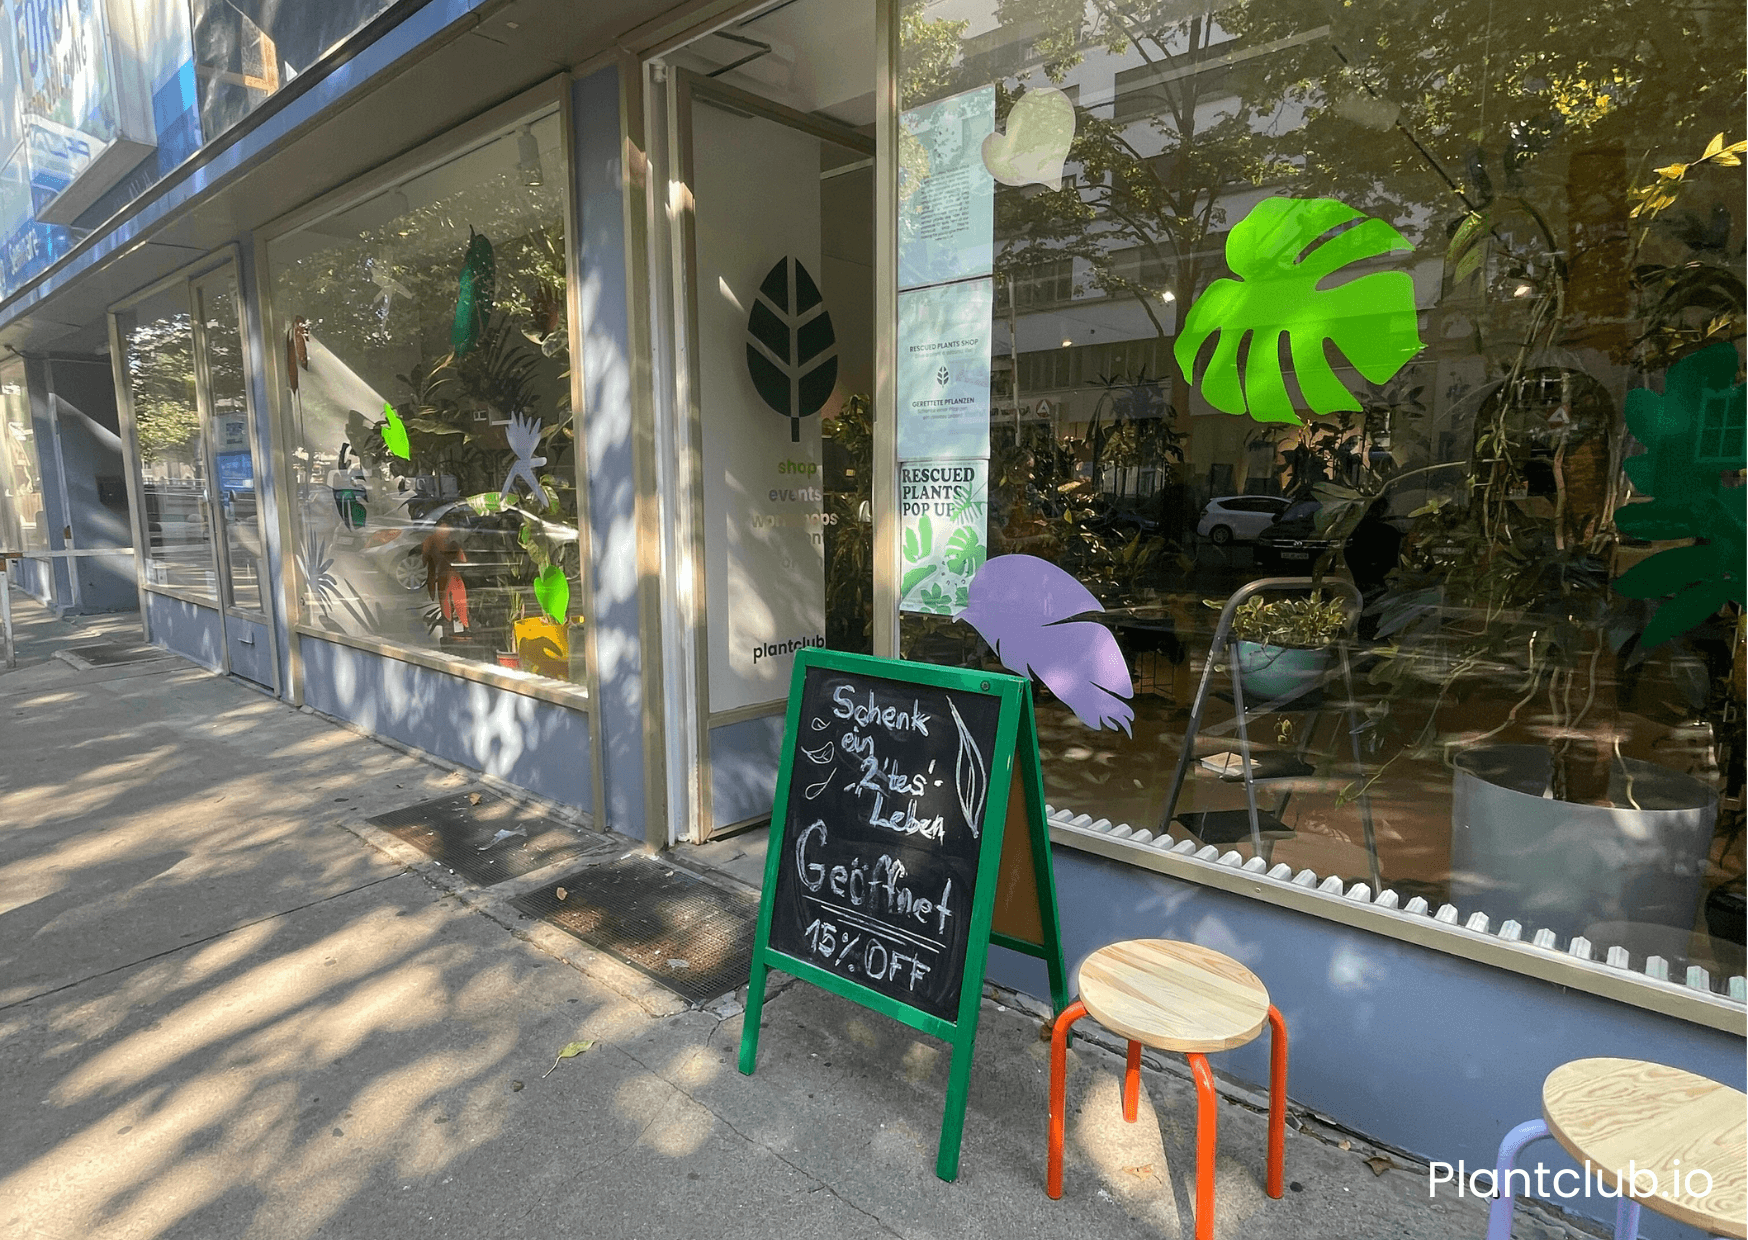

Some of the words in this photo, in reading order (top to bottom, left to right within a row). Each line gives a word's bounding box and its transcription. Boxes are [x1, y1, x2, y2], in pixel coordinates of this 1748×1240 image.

[909, 343, 937, 353] RESCUED
[937, 340, 960, 349] PLANTS
[961, 338, 979, 346] SHOP
[911, 399, 944, 408] GERETTETE
[944, 397, 975, 406] PFLANZEN
[778, 459, 817, 479] shop
[902, 467, 976, 483] RESCUED
[768, 486, 823, 502] events
[902, 485, 962, 500] PLANTS
[903, 502, 929, 516] POP
[753, 634, 825, 664] plantclub
[833, 685, 931, 737] Schenk
[841, 726, 875, 757] ein
[869, 791, 945, 846] Leben
[796, 819, 952, 935] Geöffnet
[804, 918, 861, 974] 15%
[864, 938, 931, 991] OFF
